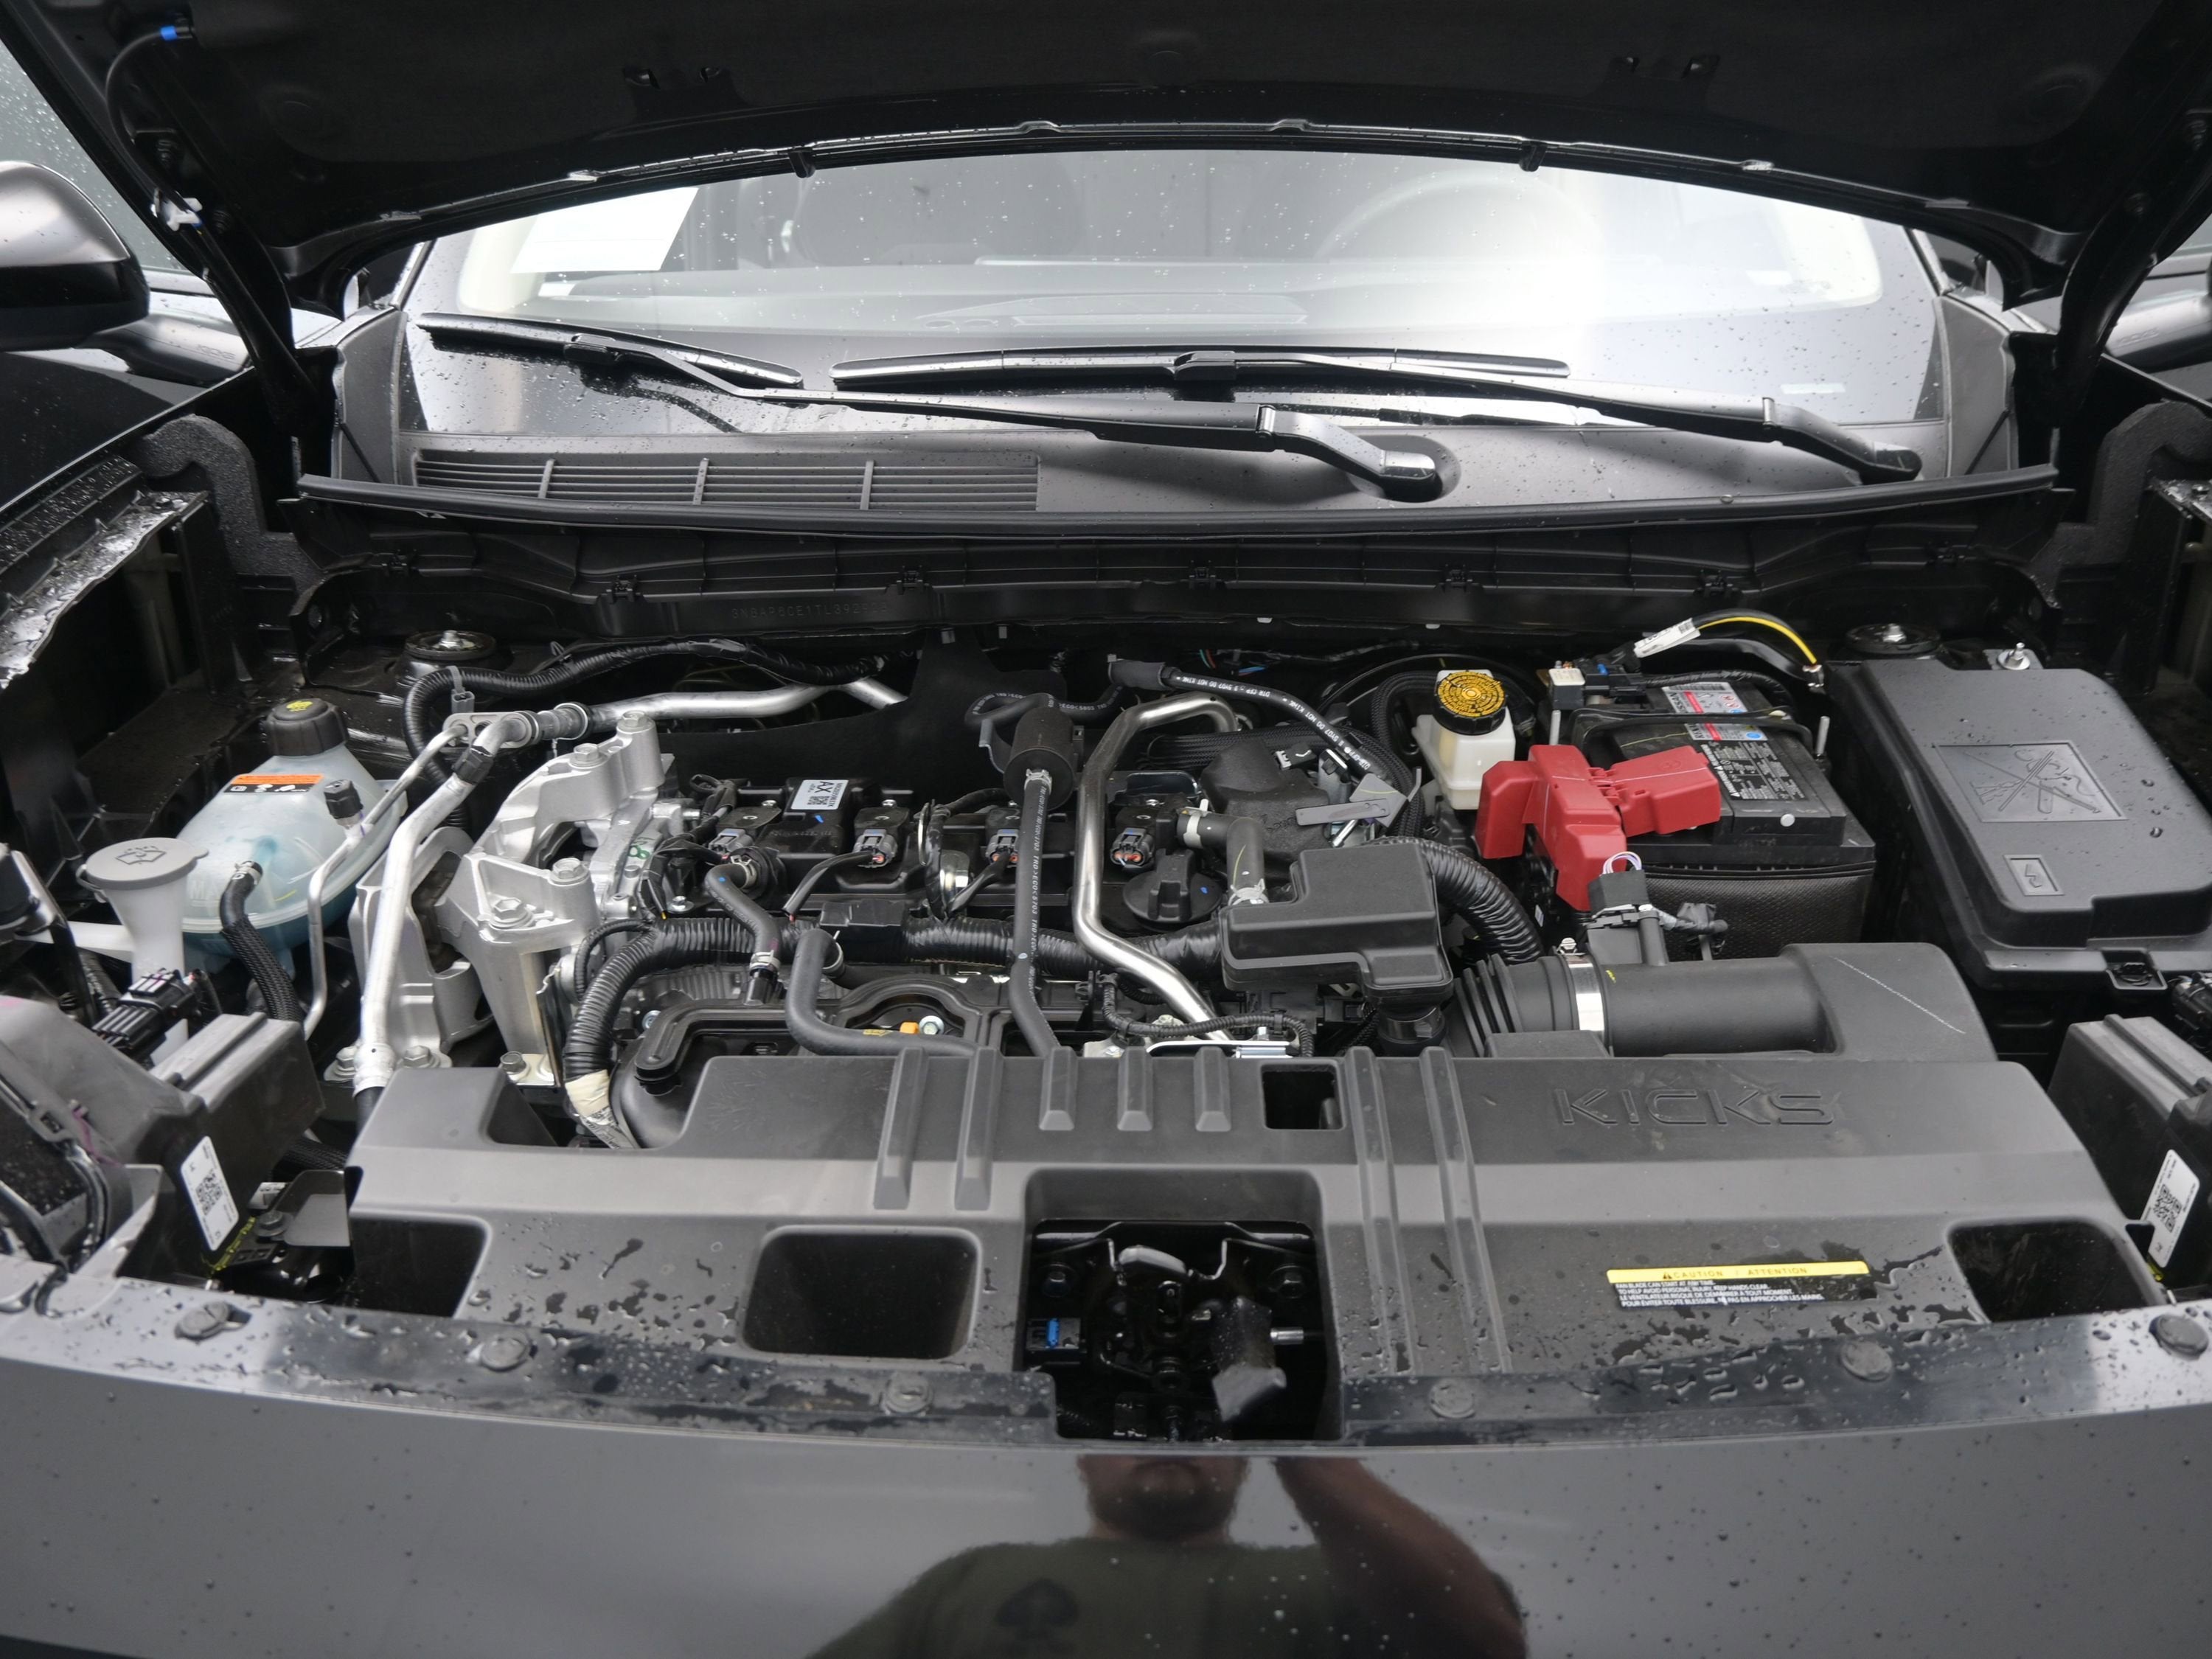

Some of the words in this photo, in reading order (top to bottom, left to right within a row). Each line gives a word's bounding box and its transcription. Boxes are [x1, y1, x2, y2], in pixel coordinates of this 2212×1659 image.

[1197, 678, 1208, 686] NOT
[1305, 712, 1317, 722] NOT
[814, 781, 834, 793] AX
[1554, 1088, 1834, 1125] KICKS
[1674, 1270, 1723, 1279] CAUTION
[1748, 1267, 1807, 1276] ATTENTION
